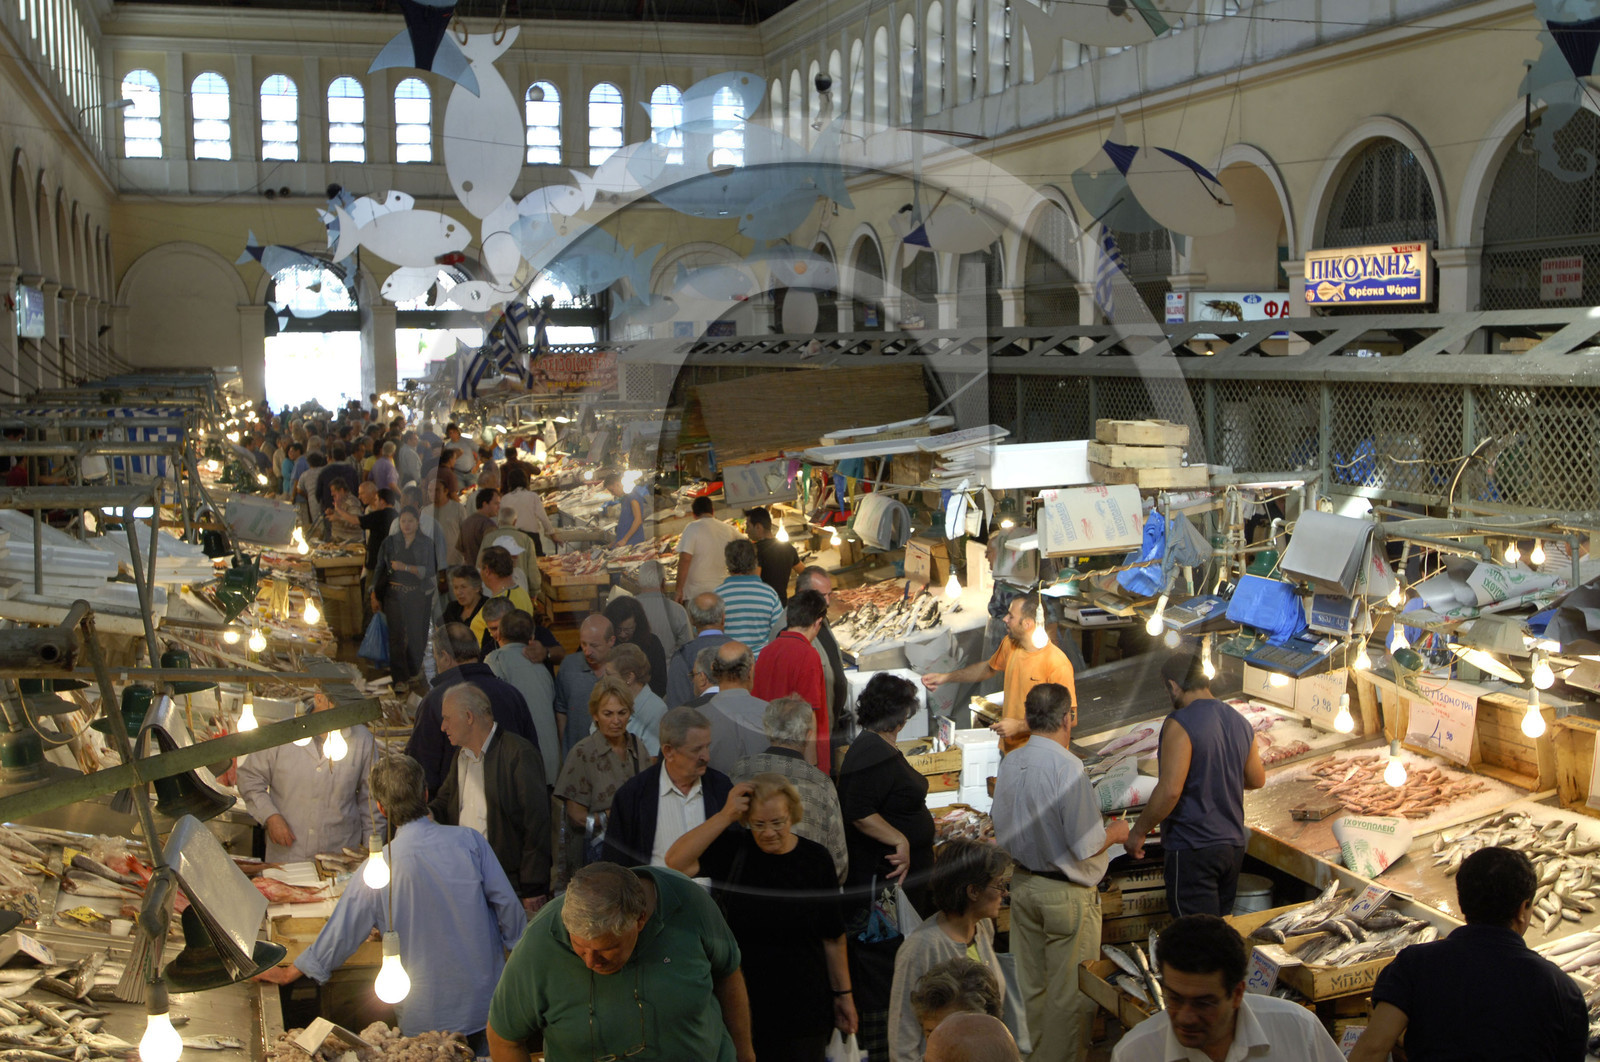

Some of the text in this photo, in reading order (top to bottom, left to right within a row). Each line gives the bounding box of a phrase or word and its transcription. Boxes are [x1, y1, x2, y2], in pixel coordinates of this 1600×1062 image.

[1311, 254, 1414, 280] ΠΙΚΟΥΝΗΣ
[1349, 284, 1417, 299] Φρέσκα Ψάρια
[1344, 818, 1396, 834] ΙΧΘΥΟΠΩΛΕΙΟ
